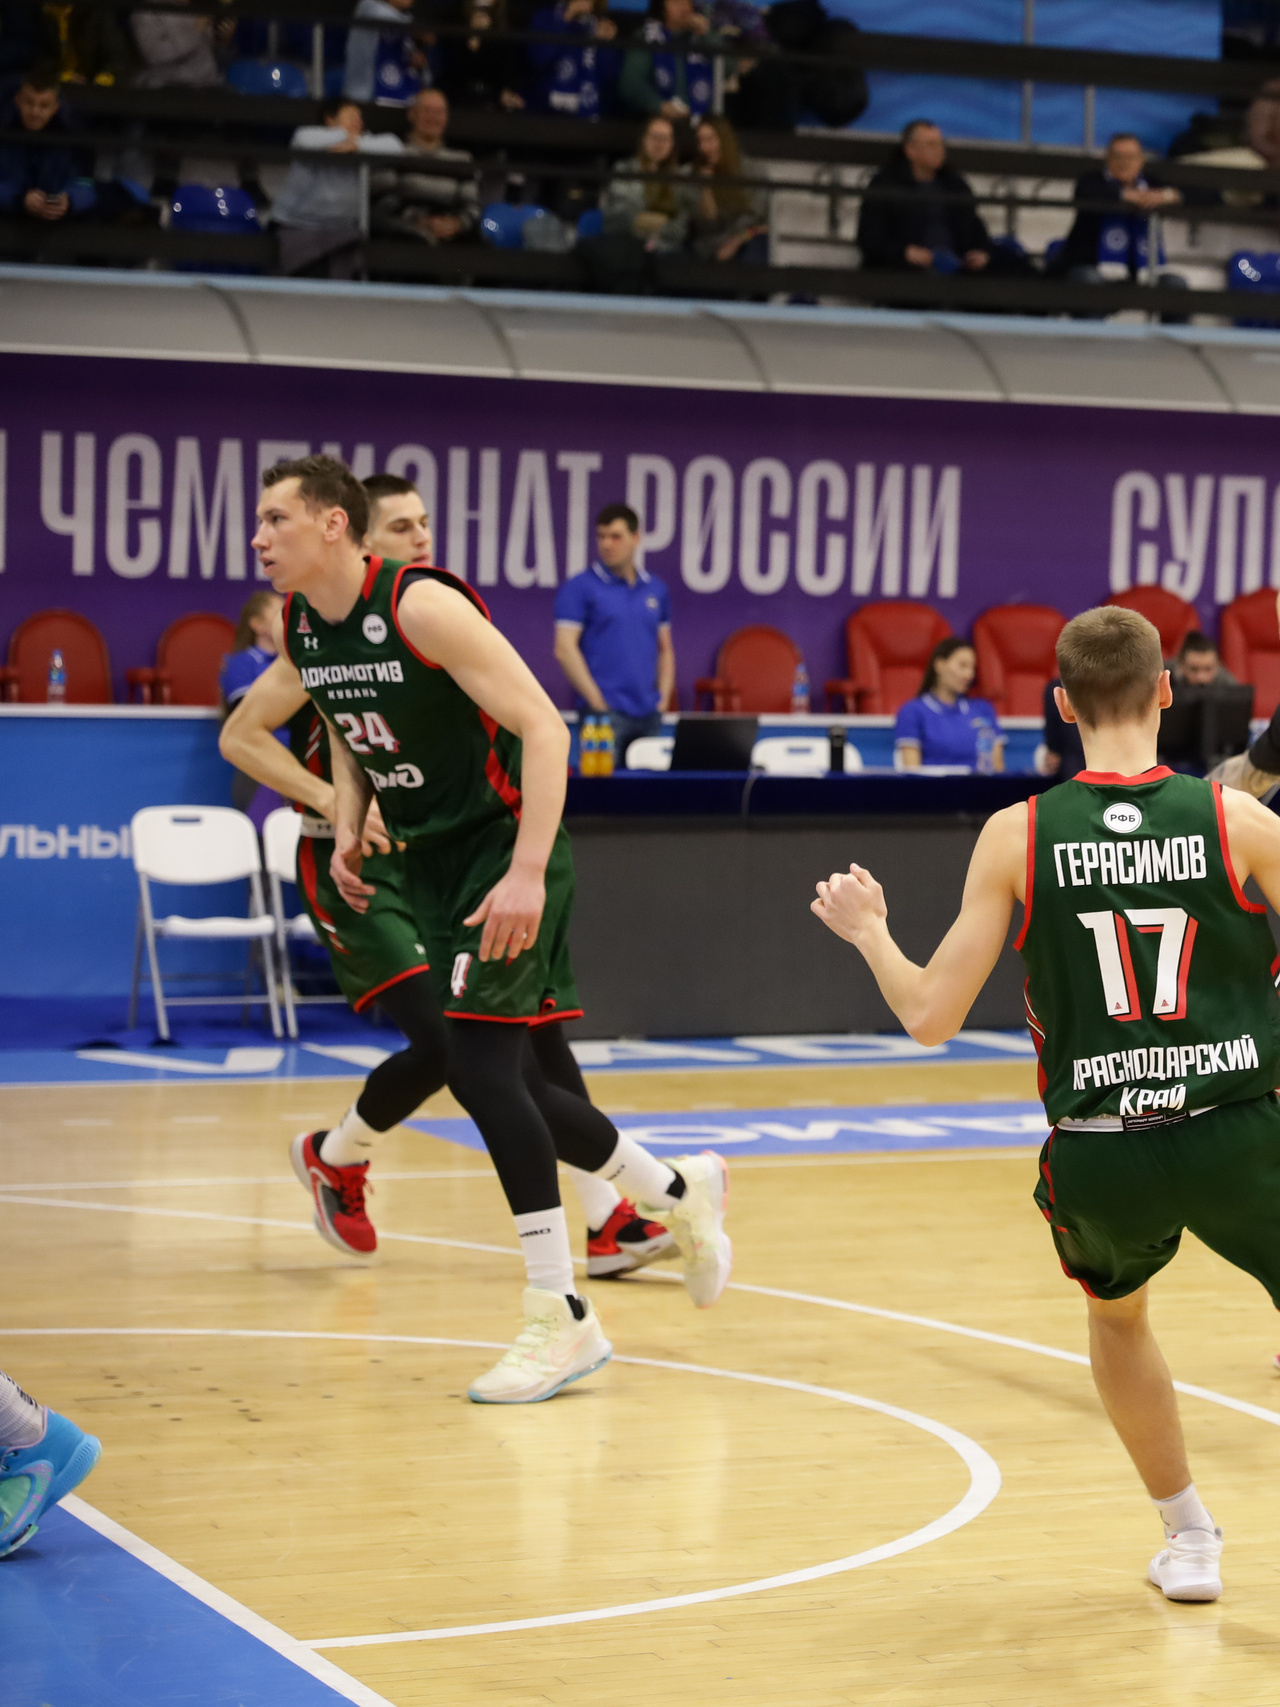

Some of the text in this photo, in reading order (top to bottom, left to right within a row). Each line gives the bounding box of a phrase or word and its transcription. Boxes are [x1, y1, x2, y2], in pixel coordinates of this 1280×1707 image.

[327, 687, 378, 700] КУБАНЬ
[334, 711, 400, 755] 24
[1109, 813, 1137, 824] РФБ
[1053, 835, 1207, 888] ГЕРАСИМОВ
[1076, 908, 1199, 1022] 17
[1119, 1083, 1187, 1117] КРАЙ
